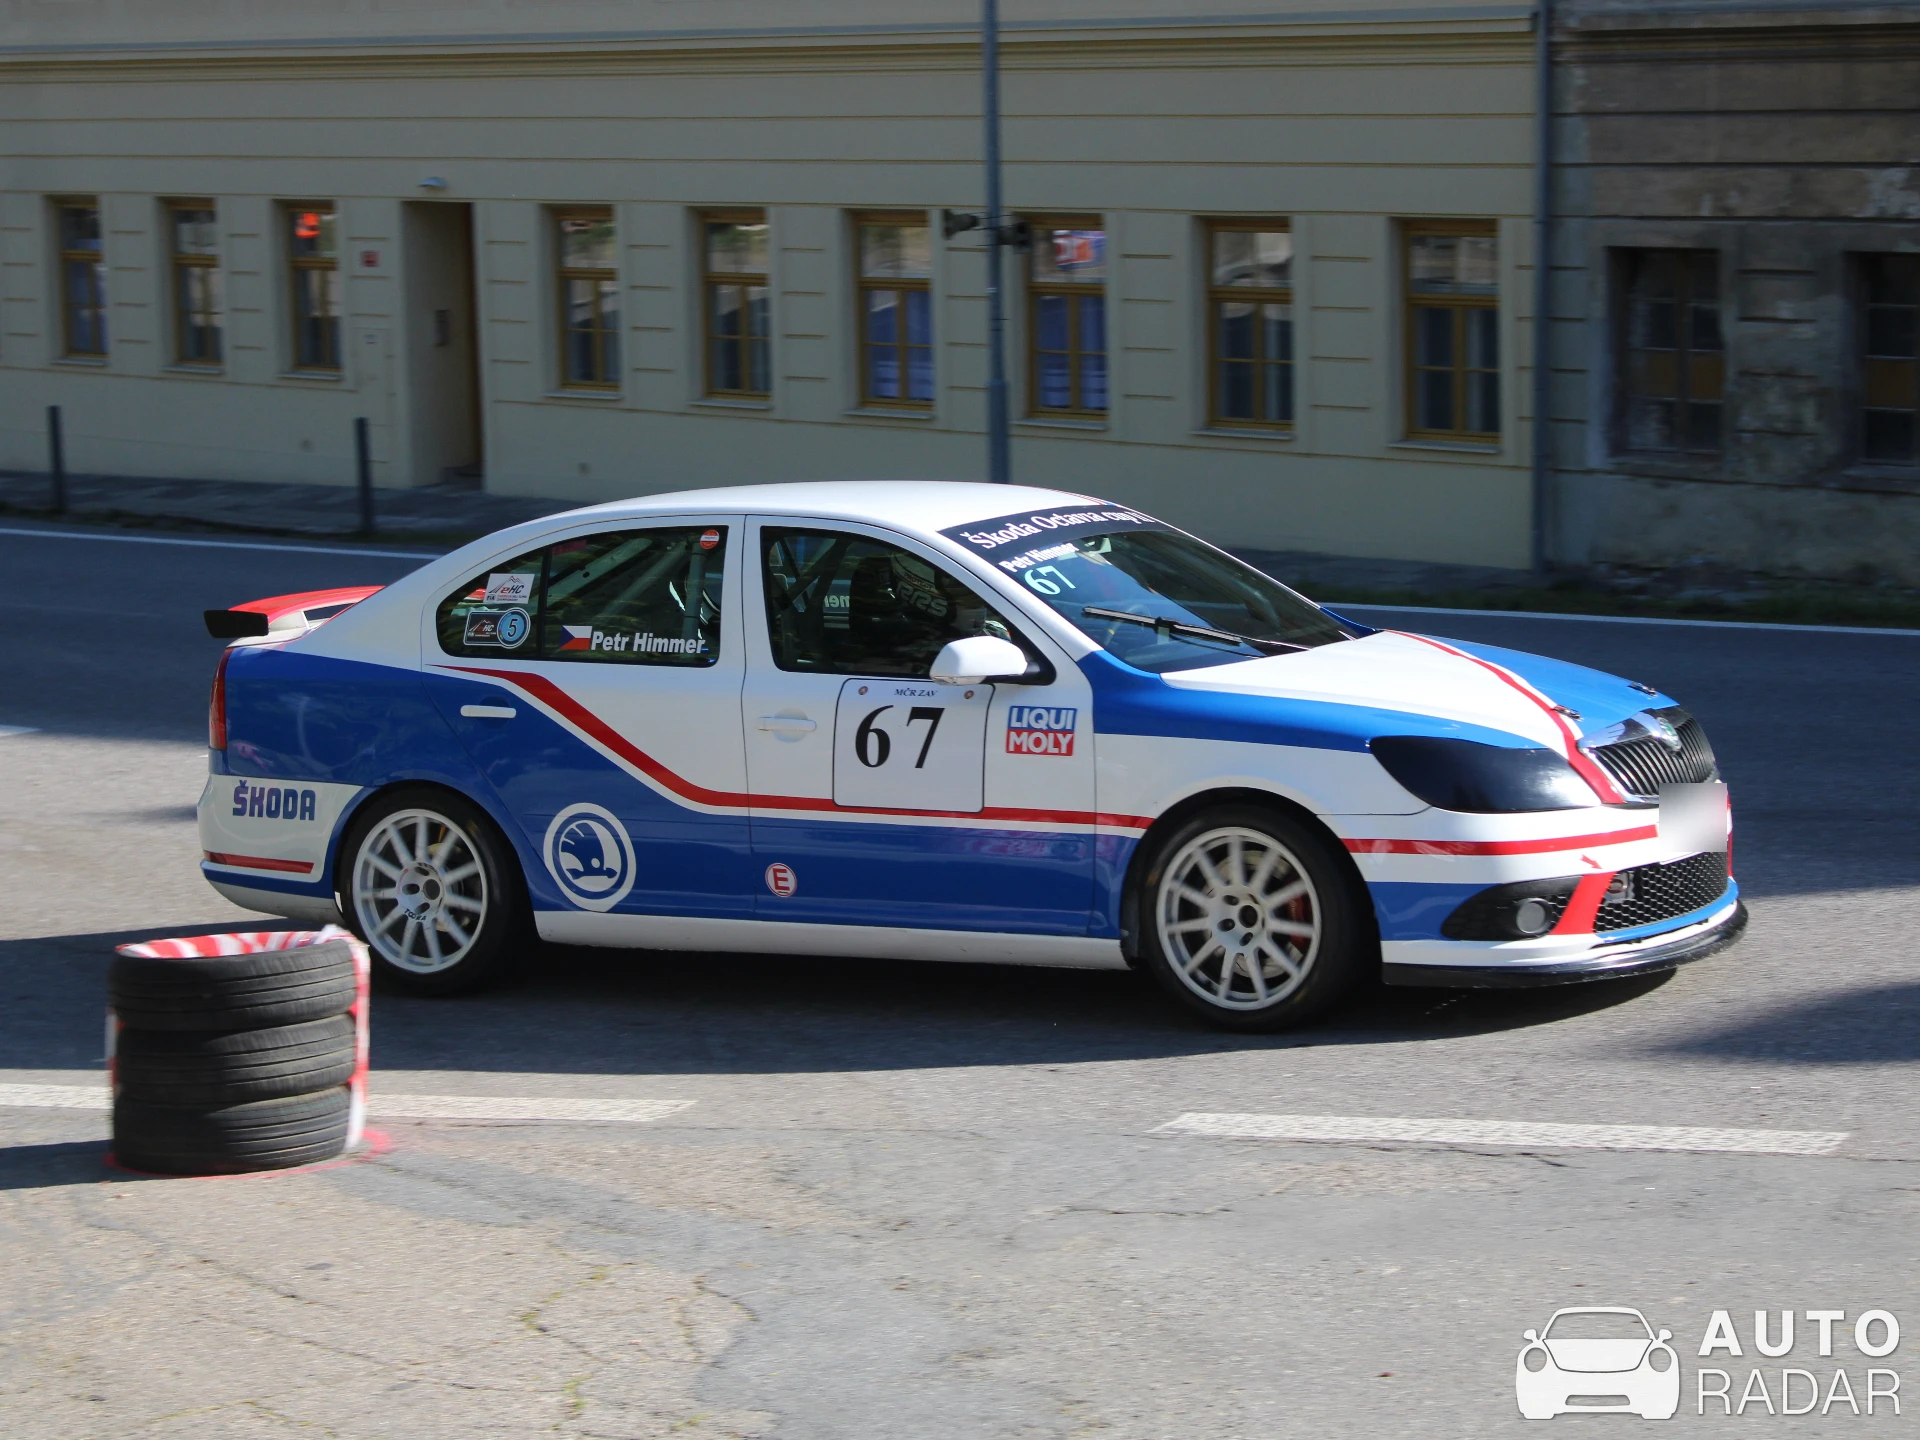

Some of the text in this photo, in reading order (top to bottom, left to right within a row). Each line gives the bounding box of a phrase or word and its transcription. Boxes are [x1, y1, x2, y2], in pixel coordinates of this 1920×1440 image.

[959, 522, 1042, 549] Škoda
[1031, 512, 1108, 530] Octavia
[998, 542, 1080, 573] Petr Himmer
[1024, 565, 1076, 595] 67
[507, 619, 519, 637] 5
[591, 631, 706, 654] Petr Himmer
[893, 687, 938, 697] MČR ZAV
[1010, 707, 1075, 730] LIQUI
[855, 704, 946, 769] 67
[1008, 731, 1074, 754] MOLY
[232, 779, 317, 821] ŠKODA
[772, 867, 791, 891] E
